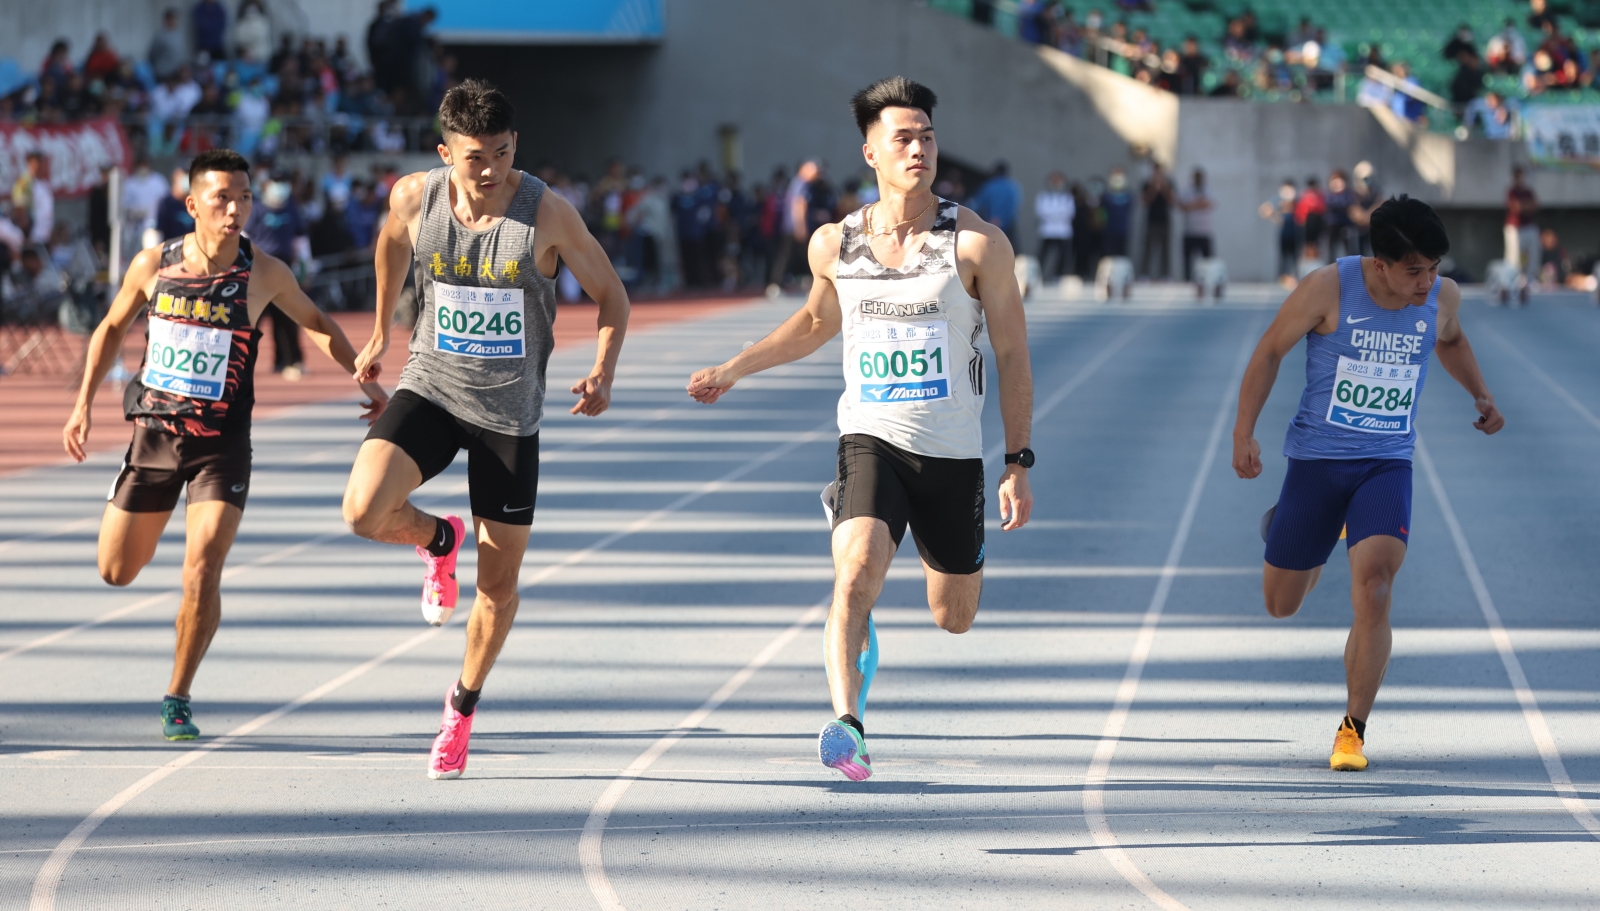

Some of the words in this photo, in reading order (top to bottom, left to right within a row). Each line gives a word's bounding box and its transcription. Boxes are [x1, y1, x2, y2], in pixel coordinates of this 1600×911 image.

[430, 253, 521, 282] 臺南大學
[921, 259, 949, 267] adidas
[442, 288, 460, 299] 2023
[438, 306, 521, 335] 60246
[861, 301, 938, 316] CHANGE
[861, 330, 881, 339] 2023
[1351, 329, 1423, 353] CHINESE
[152, 343, 225, 375] 60267
[860, 347, 942, 378] 60051
[1347, 363, 1368, 373] 2023
[1337, 380, 1412, 411] 60284
